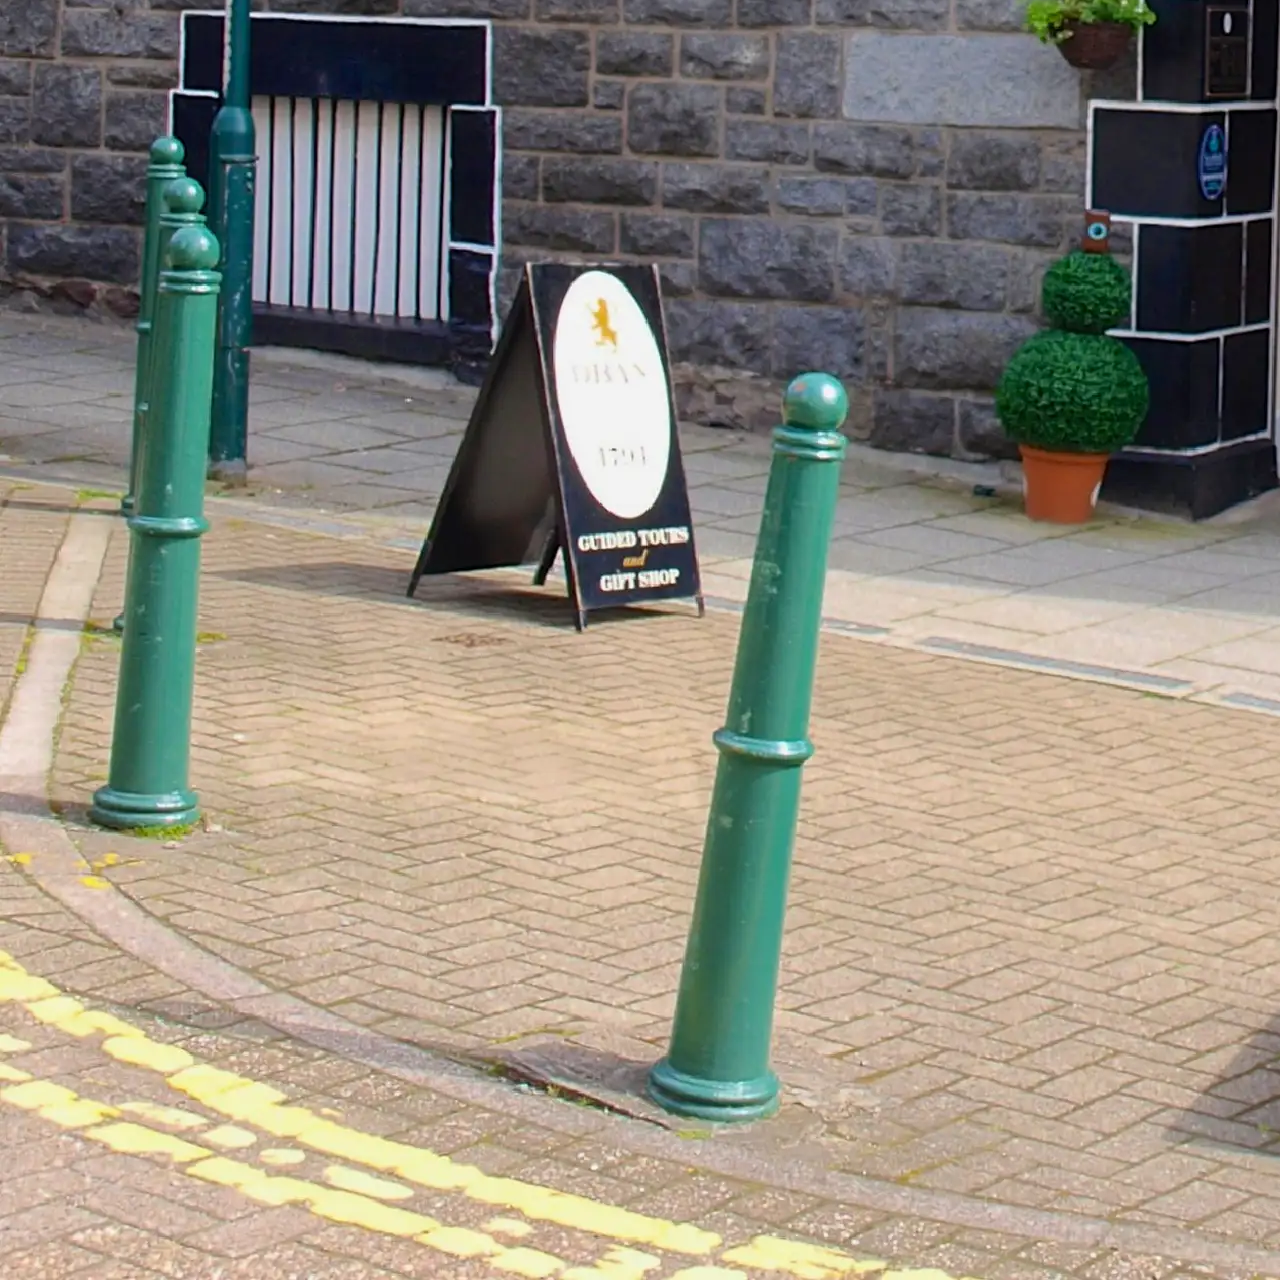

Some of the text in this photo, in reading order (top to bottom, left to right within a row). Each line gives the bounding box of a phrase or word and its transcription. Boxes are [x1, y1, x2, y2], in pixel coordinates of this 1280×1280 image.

[577, 525, 690, 552] GUIDED TOURS
[622, 548, 649, 568] and
[600, 567, 681, 592] GIFT SHOP
